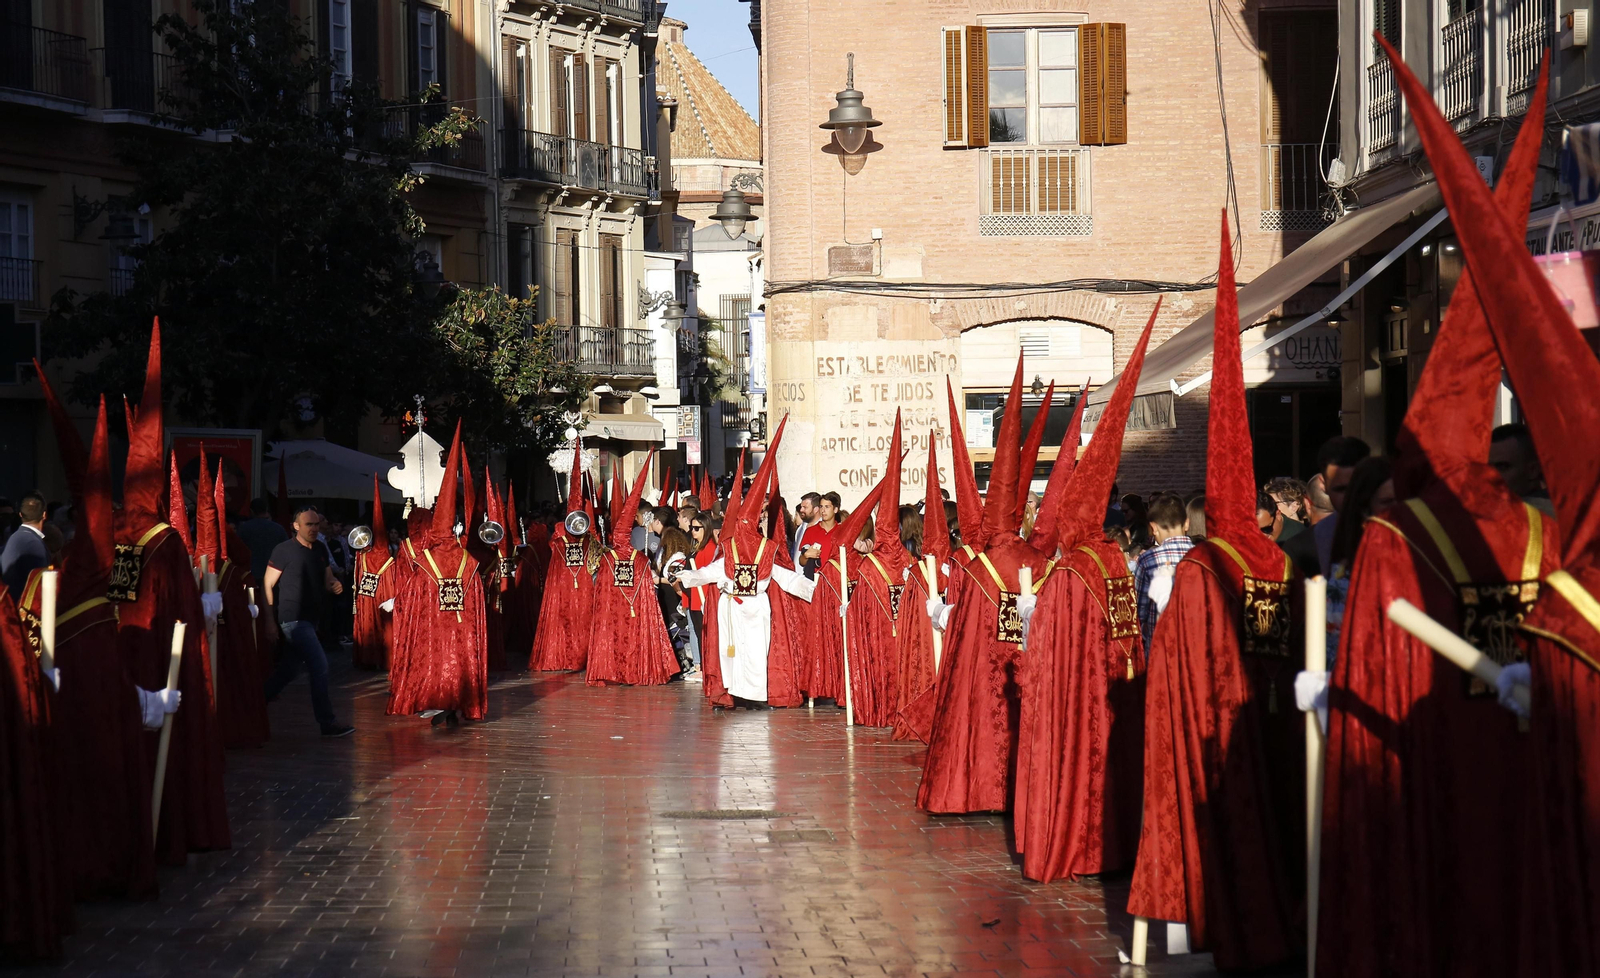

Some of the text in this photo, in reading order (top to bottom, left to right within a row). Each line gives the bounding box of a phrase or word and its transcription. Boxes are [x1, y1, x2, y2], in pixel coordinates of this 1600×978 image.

[1285, 336, 1342, 360] OHAN
[821, 434, 892, 452] ARTICLOS
[911, 434, 951, 451] PUTO
